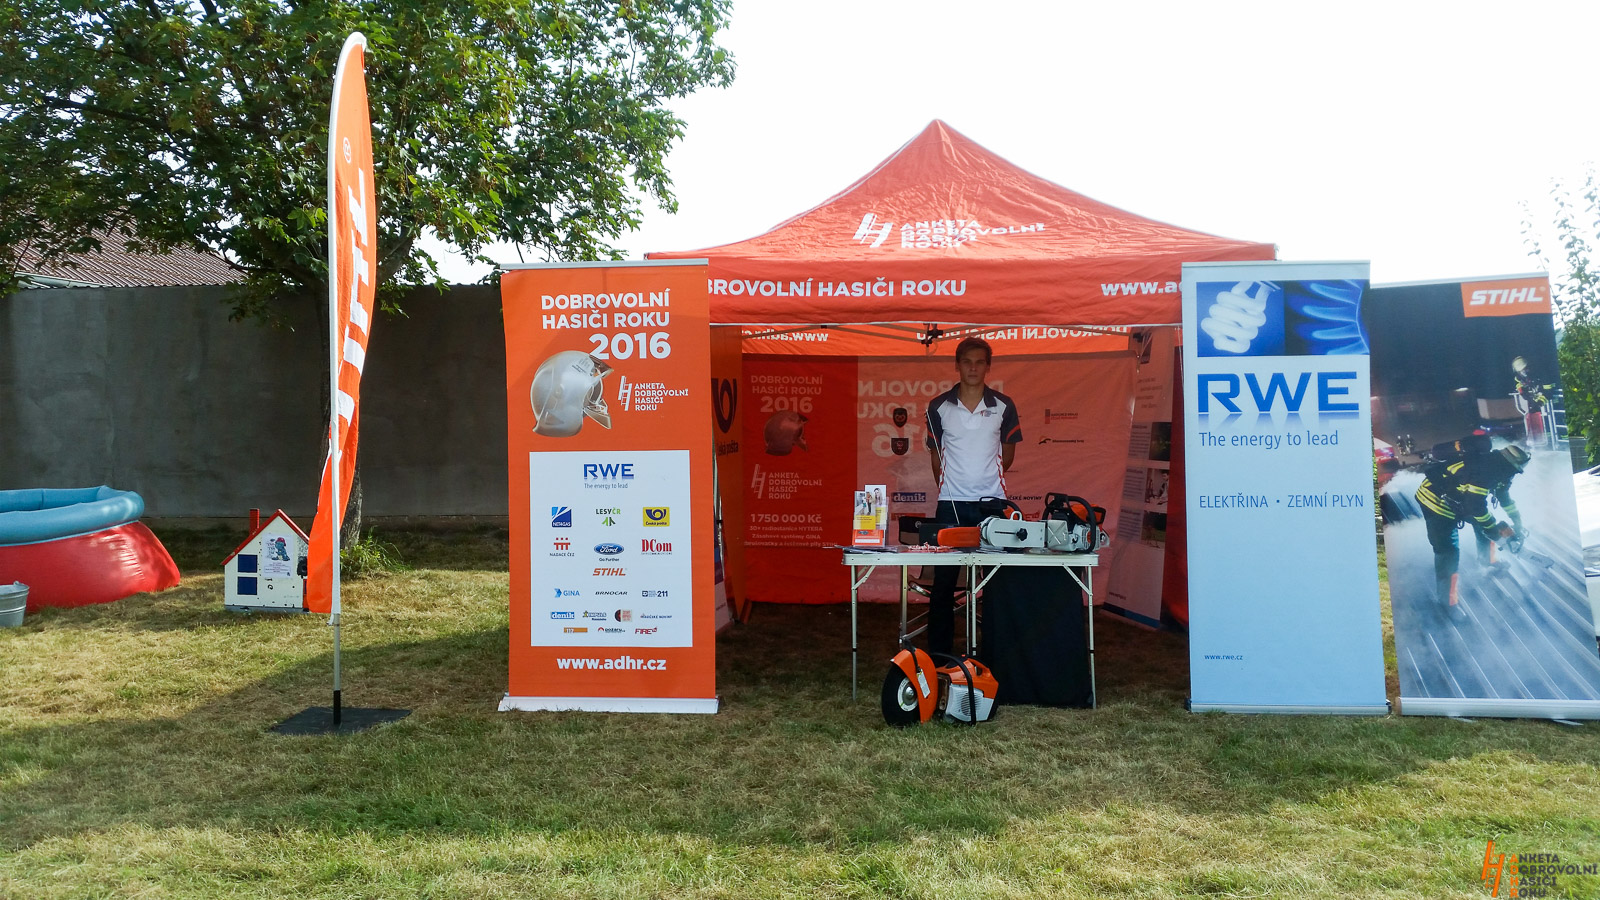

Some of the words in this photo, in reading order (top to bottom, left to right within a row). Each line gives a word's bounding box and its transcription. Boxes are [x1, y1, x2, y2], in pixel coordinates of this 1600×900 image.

[900, 219, 981, 230] ANKETA
[707, 278, 814, 297] BROVOLNÍ
[818, 277, 894, 297] HASIČI
[901, 279, 966, 296] ROKU
[1101, 280, 1182, 296] www.a
[541, 288, 671, 310] DOBROVOLNÍ
[1469, 287, 1543, 306] STIHL
[542, 310, 608, 330] HASIČI
[614, 312, 670, 328] ROKU
[588, 332, 672, 360] 2016
[751, 375, 823, 385] DOBROVOLNÍ
[634, 388, 689, 397] DOBROVOLNÍ
[752, 384, 788, 394] HASIČI
[791, 386, 822, 395] ROKU
[1197, 371, 1360, 413] RWE
[634, 396, 664, 404] HASIČI
[634, 403, 657, 411] ROKU
[760, 396, 813, 413] 2016
[1199, 431, 1226, 447] The
[1231, 434, 1282, 449] energy
[1286, 432, 1302, 446] to
[1306, 430, 1339, 446] lead
[583, 463, 634, 478] RWE
[1199, 492, 1269, 508] ELEKTŘINA
[1287, 491, 1328, 508] ZEMNÍ
[1332, 494, 1364, 508] PLYN
[781, 514, 805, 523] 000
[807, 513, 822, 523] Kč
[600, 545, 619, 553] Ford
[641, 539, 672, 552] DCom
[592, 567, 626, 576] STIHL
[556, 655, 667, 670] www.adhr.cz
